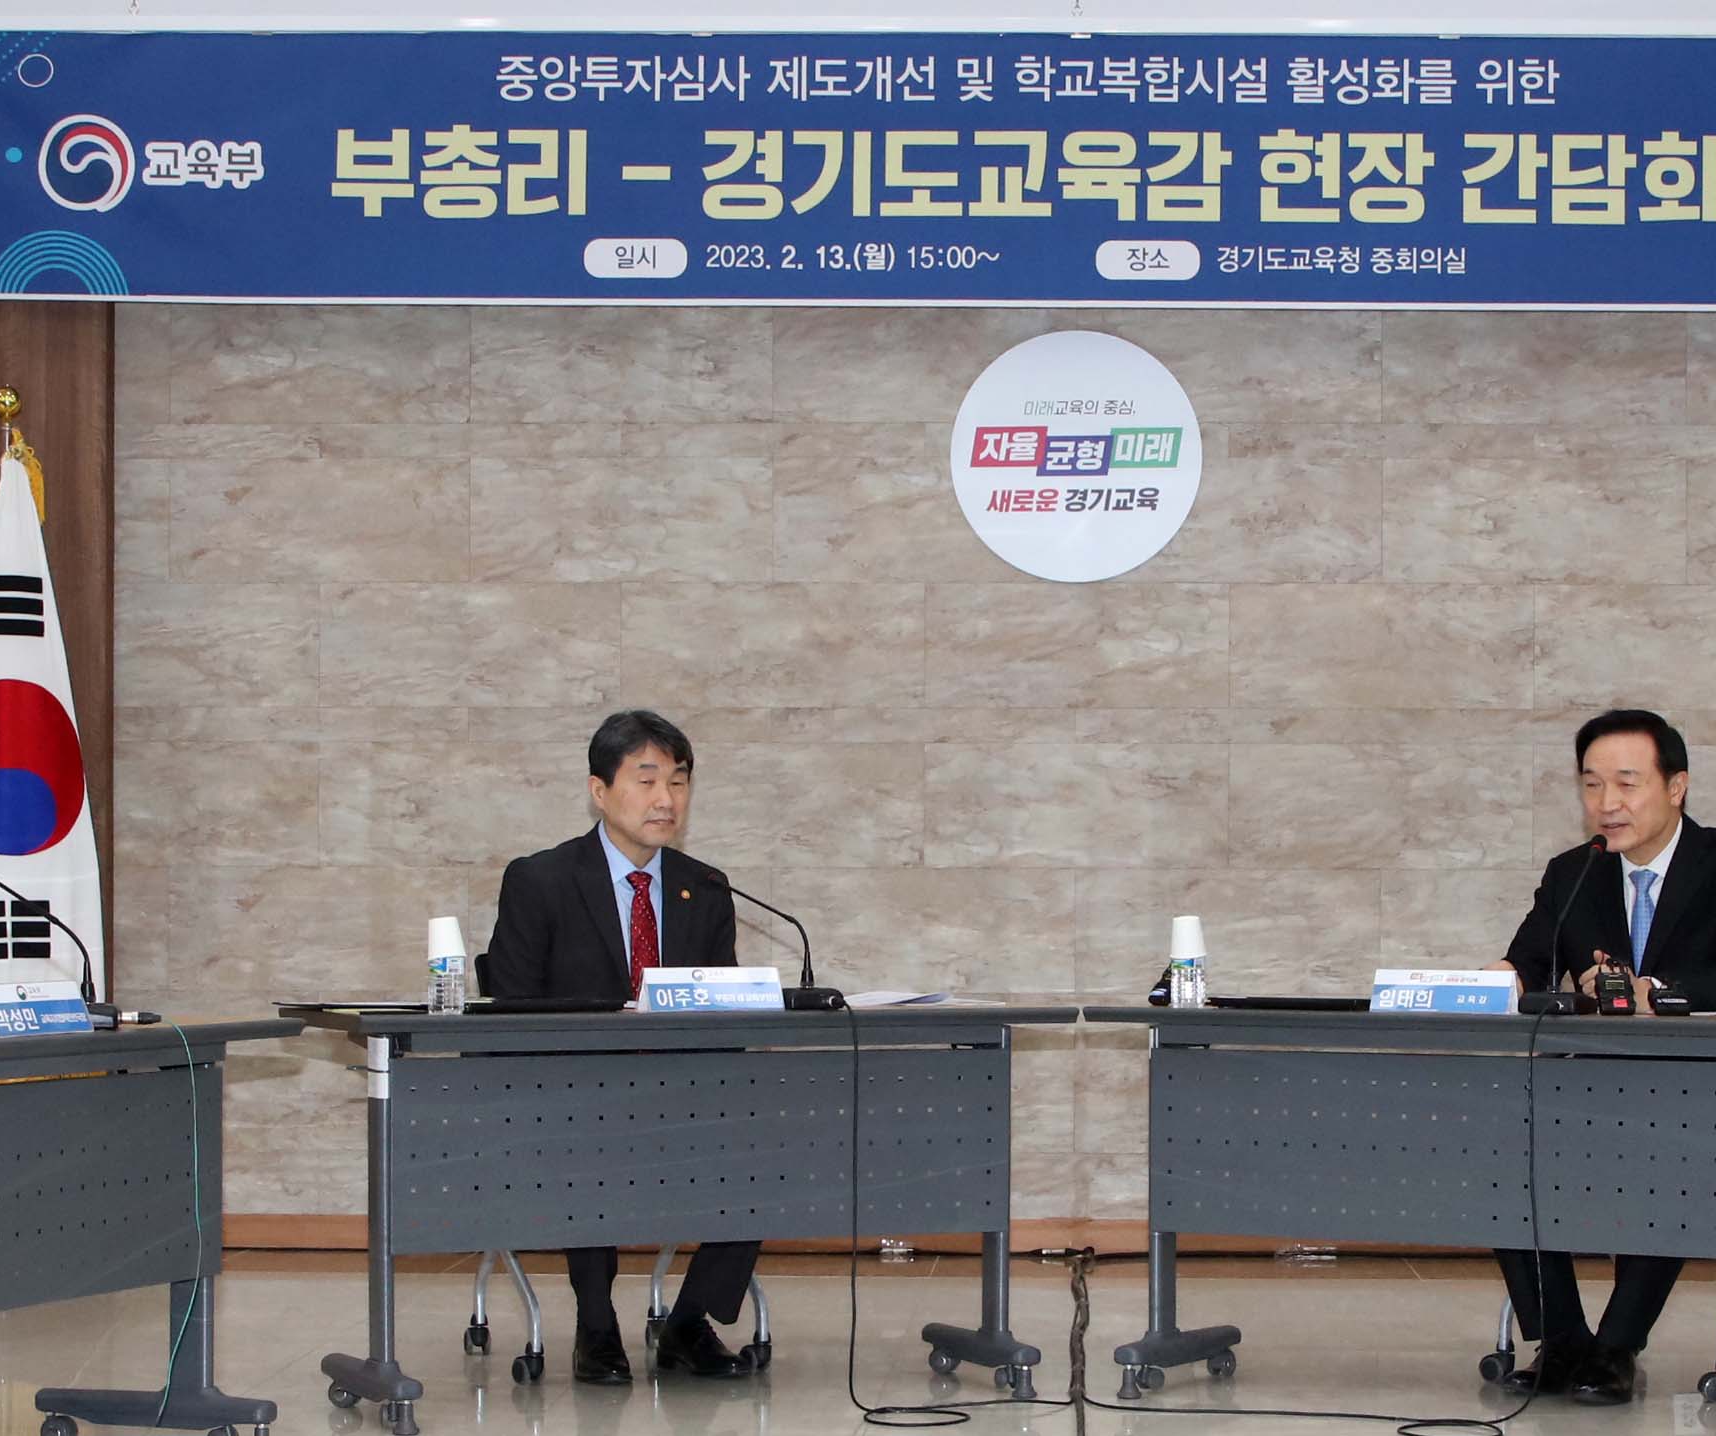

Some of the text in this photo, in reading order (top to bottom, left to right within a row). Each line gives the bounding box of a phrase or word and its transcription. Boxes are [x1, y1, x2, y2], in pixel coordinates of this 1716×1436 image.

[495, 54, 1560, 106] 중앙투자심사 제도개선 및 학교복합시설 활성화를 위한
[148, 145, 262, 185] 교육부
[331, 124, 588, 219] 부총리
[621, 165, 671, 181] -
[701, 129, 1233, 222] 경기도교육감
[1259, 128, 1435, 224] 현장
[615, 245, 656, 269] 일시
[706, 242, 1000, 272] 2023. 2. 13.(월) 15:00~
[1127, 247, 1170, 272] 장소
[1217, 245, 1466, 274] 경기도교육청 중회의실
[1023, 400, 1099, 416] 미래교육의
[978, 431, 1176, 472] 자율 균형 미래
[986, 488, 1160, 513] 새로운 경기교육
[655, 988, 712, 1008] 이주호
[1379, 989, 1434, 1009] 임태희
